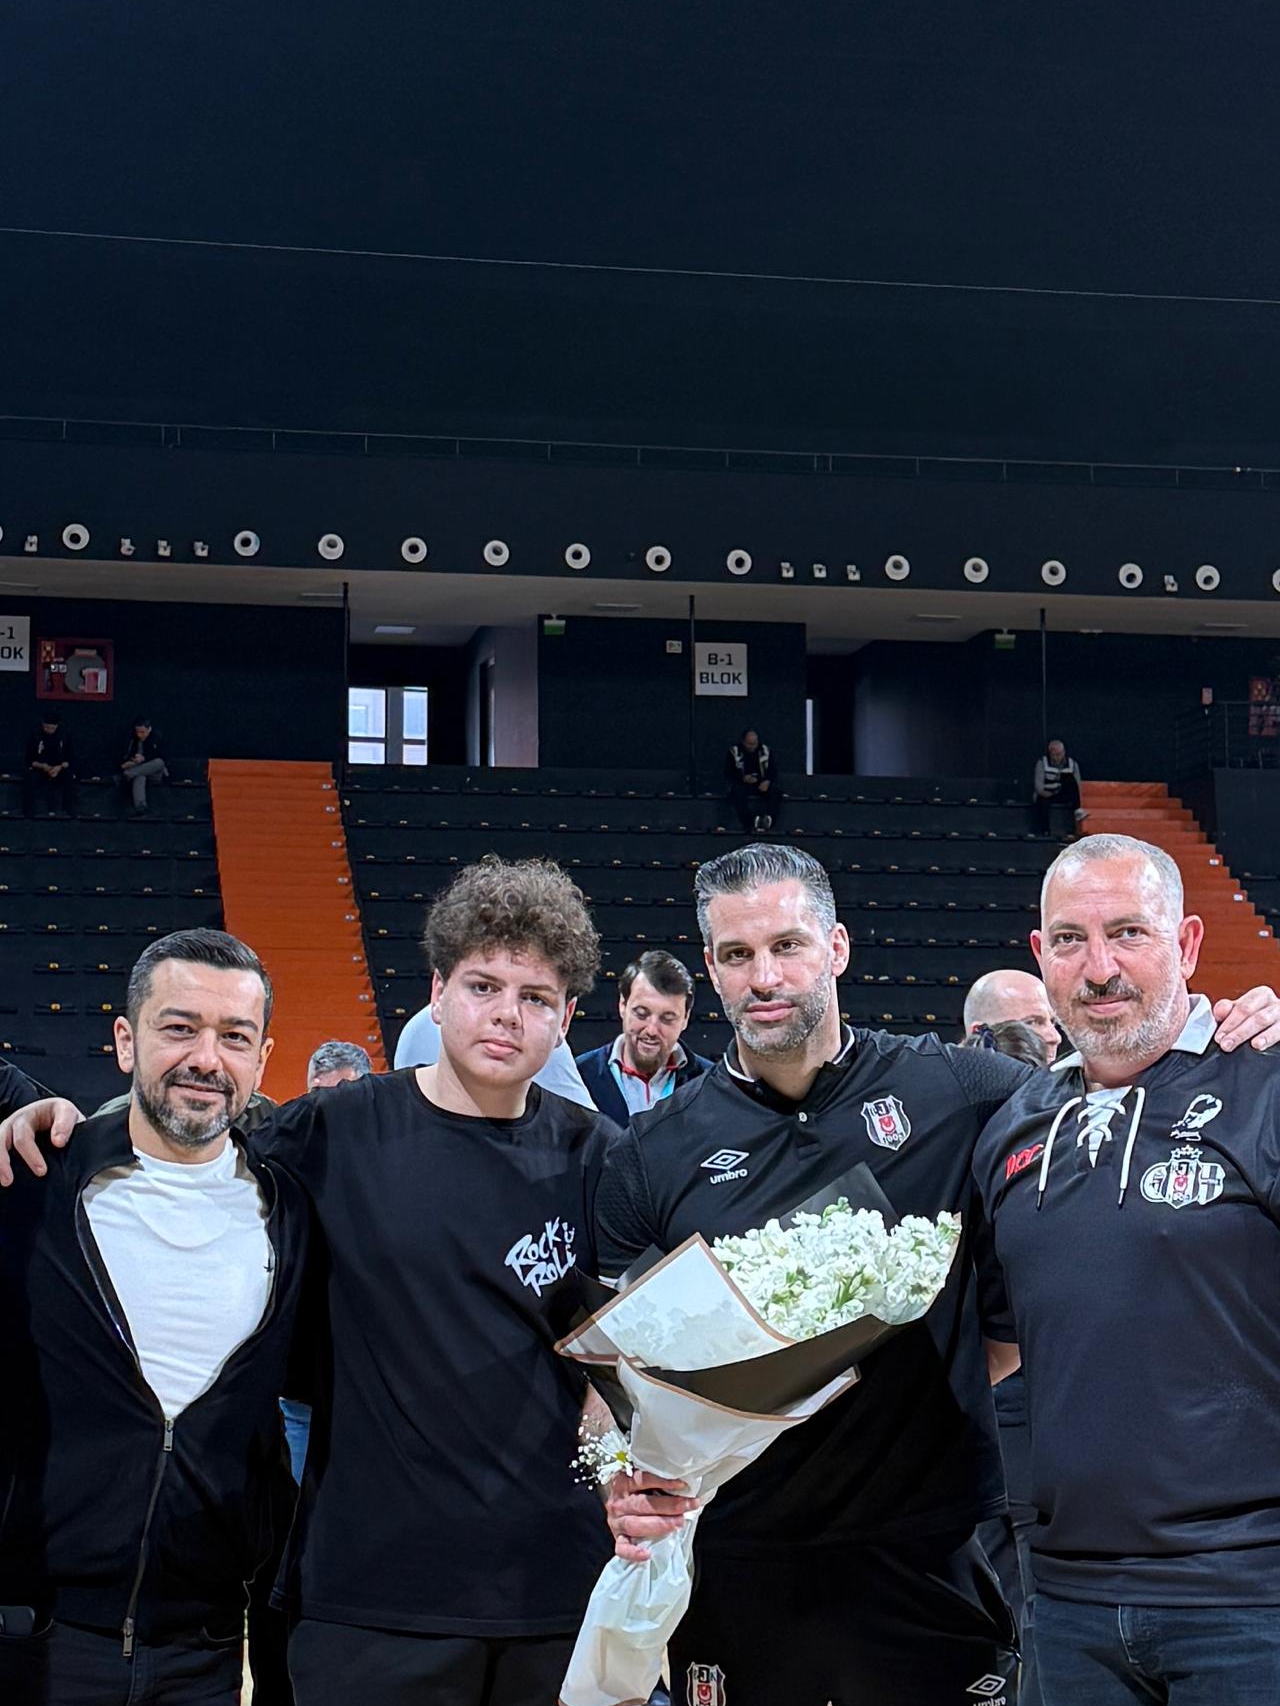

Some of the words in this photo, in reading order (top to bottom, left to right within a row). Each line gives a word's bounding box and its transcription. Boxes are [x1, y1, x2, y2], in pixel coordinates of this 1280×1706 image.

[707, 653, 734, 665] B-1
[699, 672, 742, 685] BLOK
[710, 1168, 748, 1184] umbro
